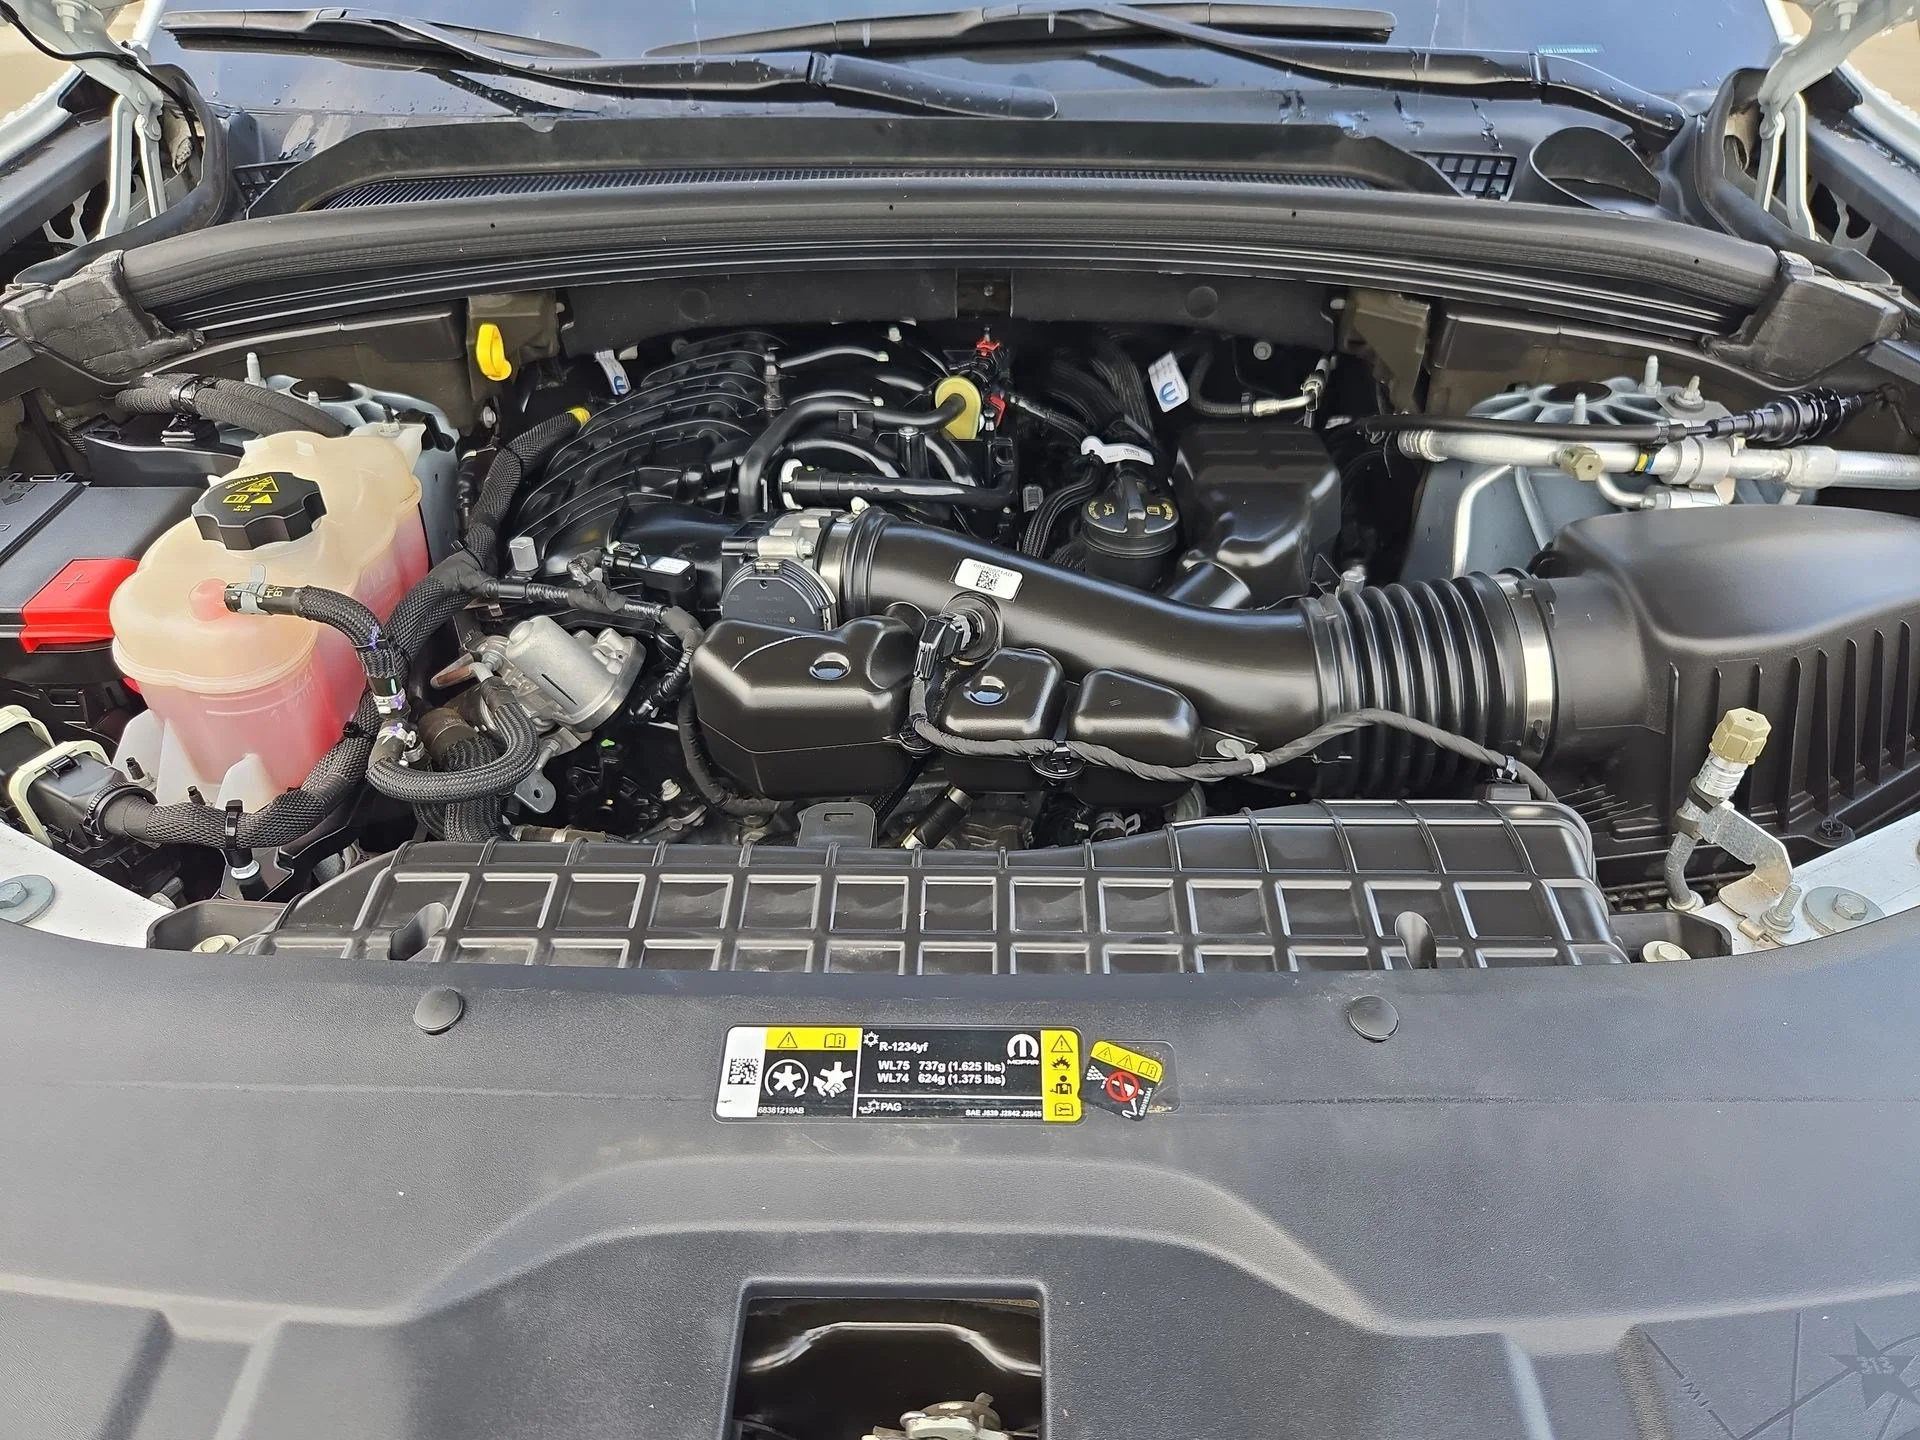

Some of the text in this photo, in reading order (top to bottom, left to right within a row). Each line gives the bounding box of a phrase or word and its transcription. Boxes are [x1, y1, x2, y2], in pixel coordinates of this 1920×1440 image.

[878, 1041, 929, 1054] R-1234yf
[878, 1060, 1006, 1073] WL75 737g (1.625 lbs)
[877, 1073, 1006, 1086] WL74 624g (1.375 lbs)
[880, 1102, 902, 1112] PAG
